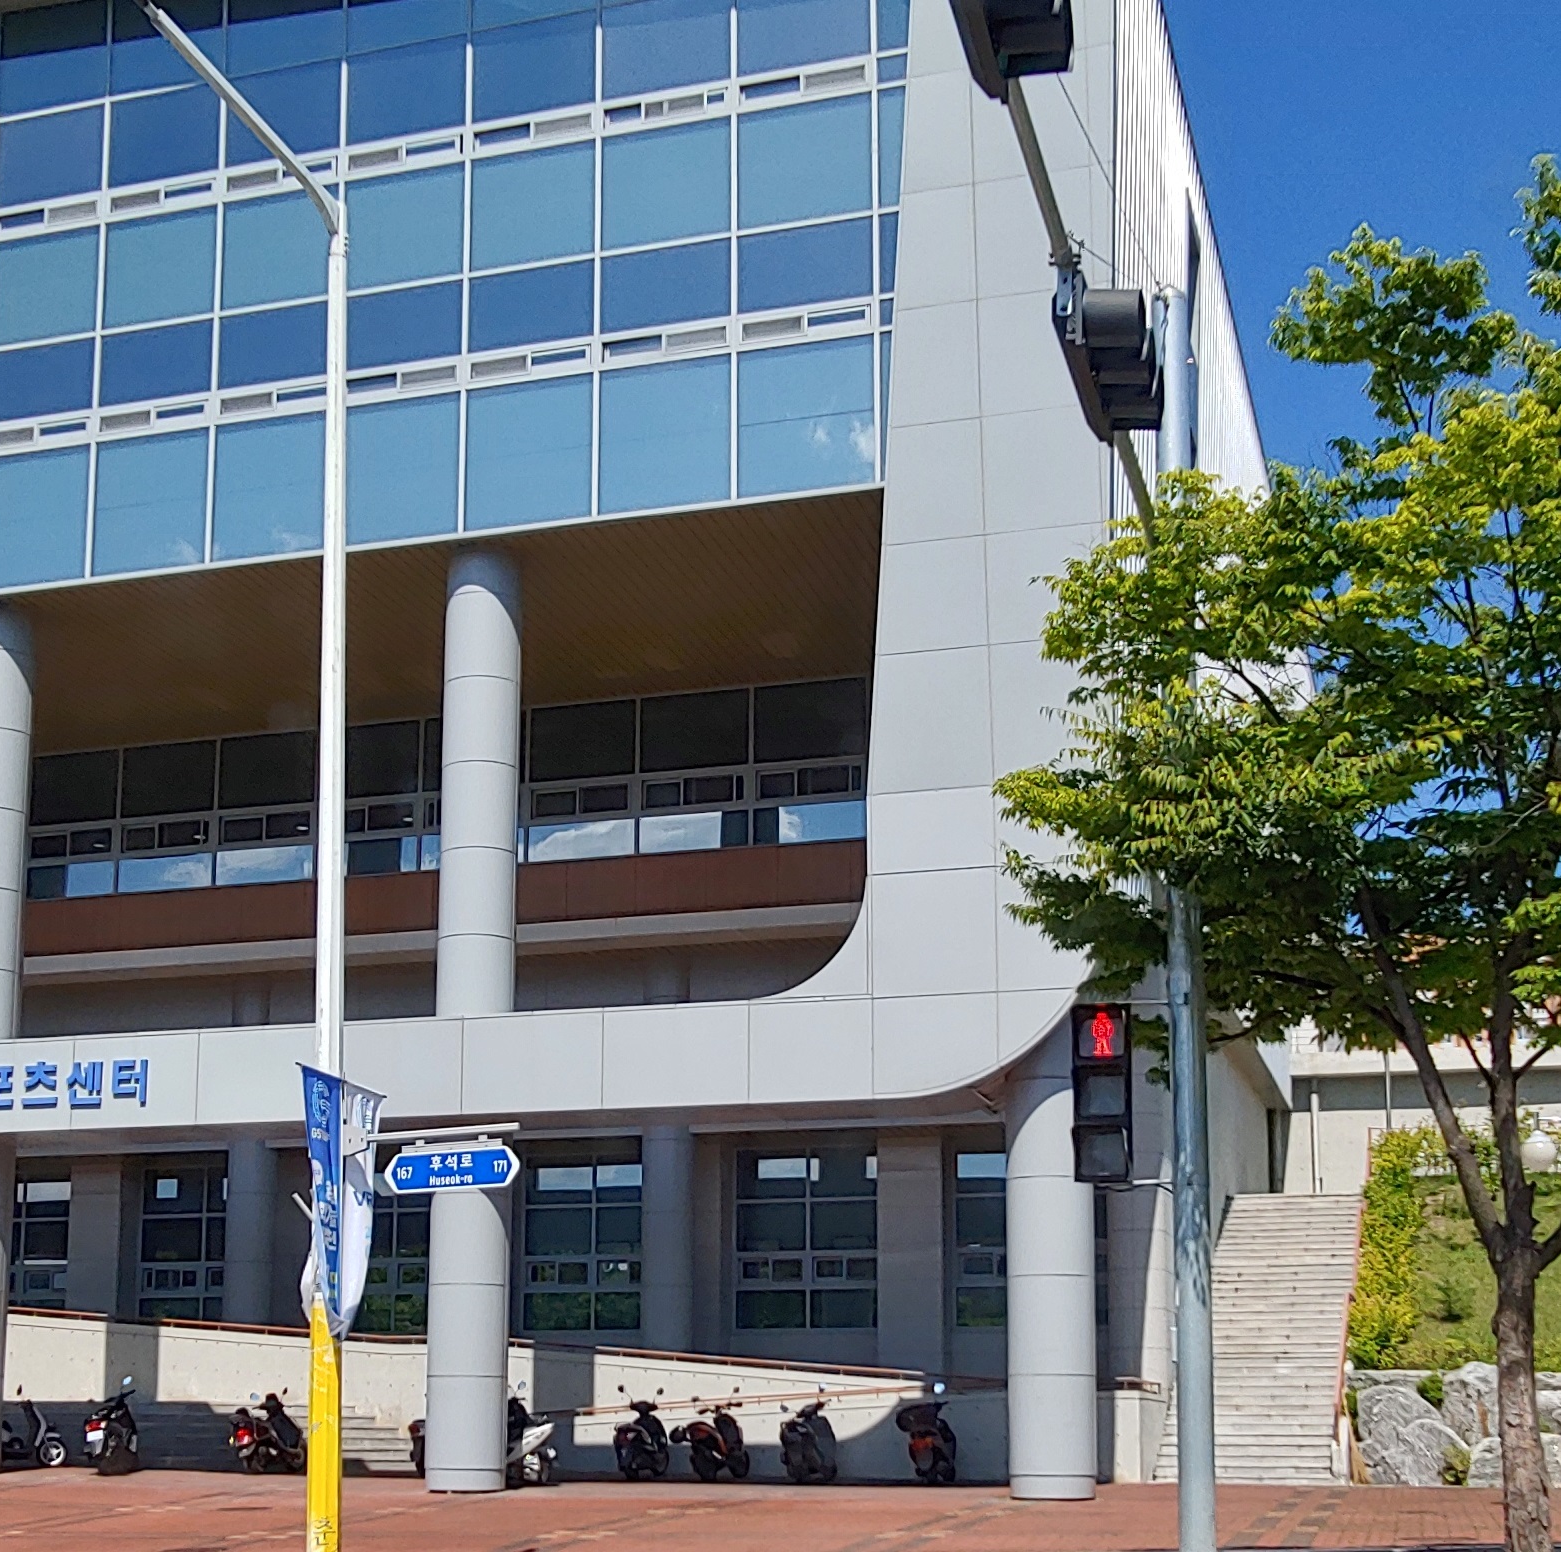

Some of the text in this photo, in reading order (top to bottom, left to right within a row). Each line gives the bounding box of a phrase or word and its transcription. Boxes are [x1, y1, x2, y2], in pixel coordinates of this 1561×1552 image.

[429, 1153, 473, 1171] 후석로
[493, 1160, 508, 1173] 171
[396, 1166, 413, 1180] 167
[429, 1174, 473, 1186] Huseok-ro
